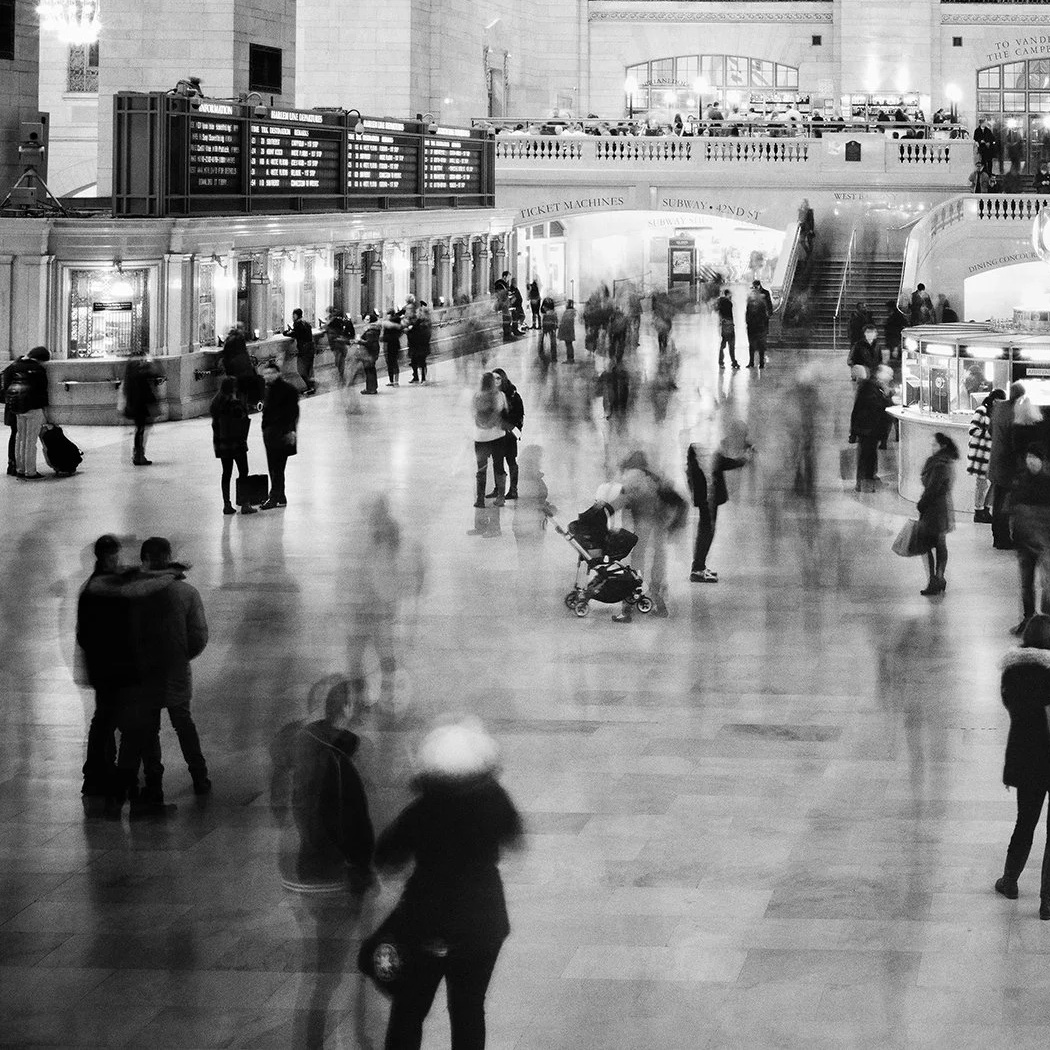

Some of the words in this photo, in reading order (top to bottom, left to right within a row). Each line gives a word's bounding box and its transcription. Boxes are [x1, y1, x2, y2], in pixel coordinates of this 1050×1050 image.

[995, 41, 1010, 50] TO
[987, 50, 1010, 62] THE
[520, 202, 561, 219] TICKET
[563, 196, 624, 210] MACHINES
[662, 198, 707, 210] SUBWAY
[716, 204, 745, 216] 42ND
[746, 210, 762, 220] ST
[648, 216, 687, 227] SUBWAY
[968, 258, 998, 273] DINING
[999, 252, 1038, 263] CONCOUR
